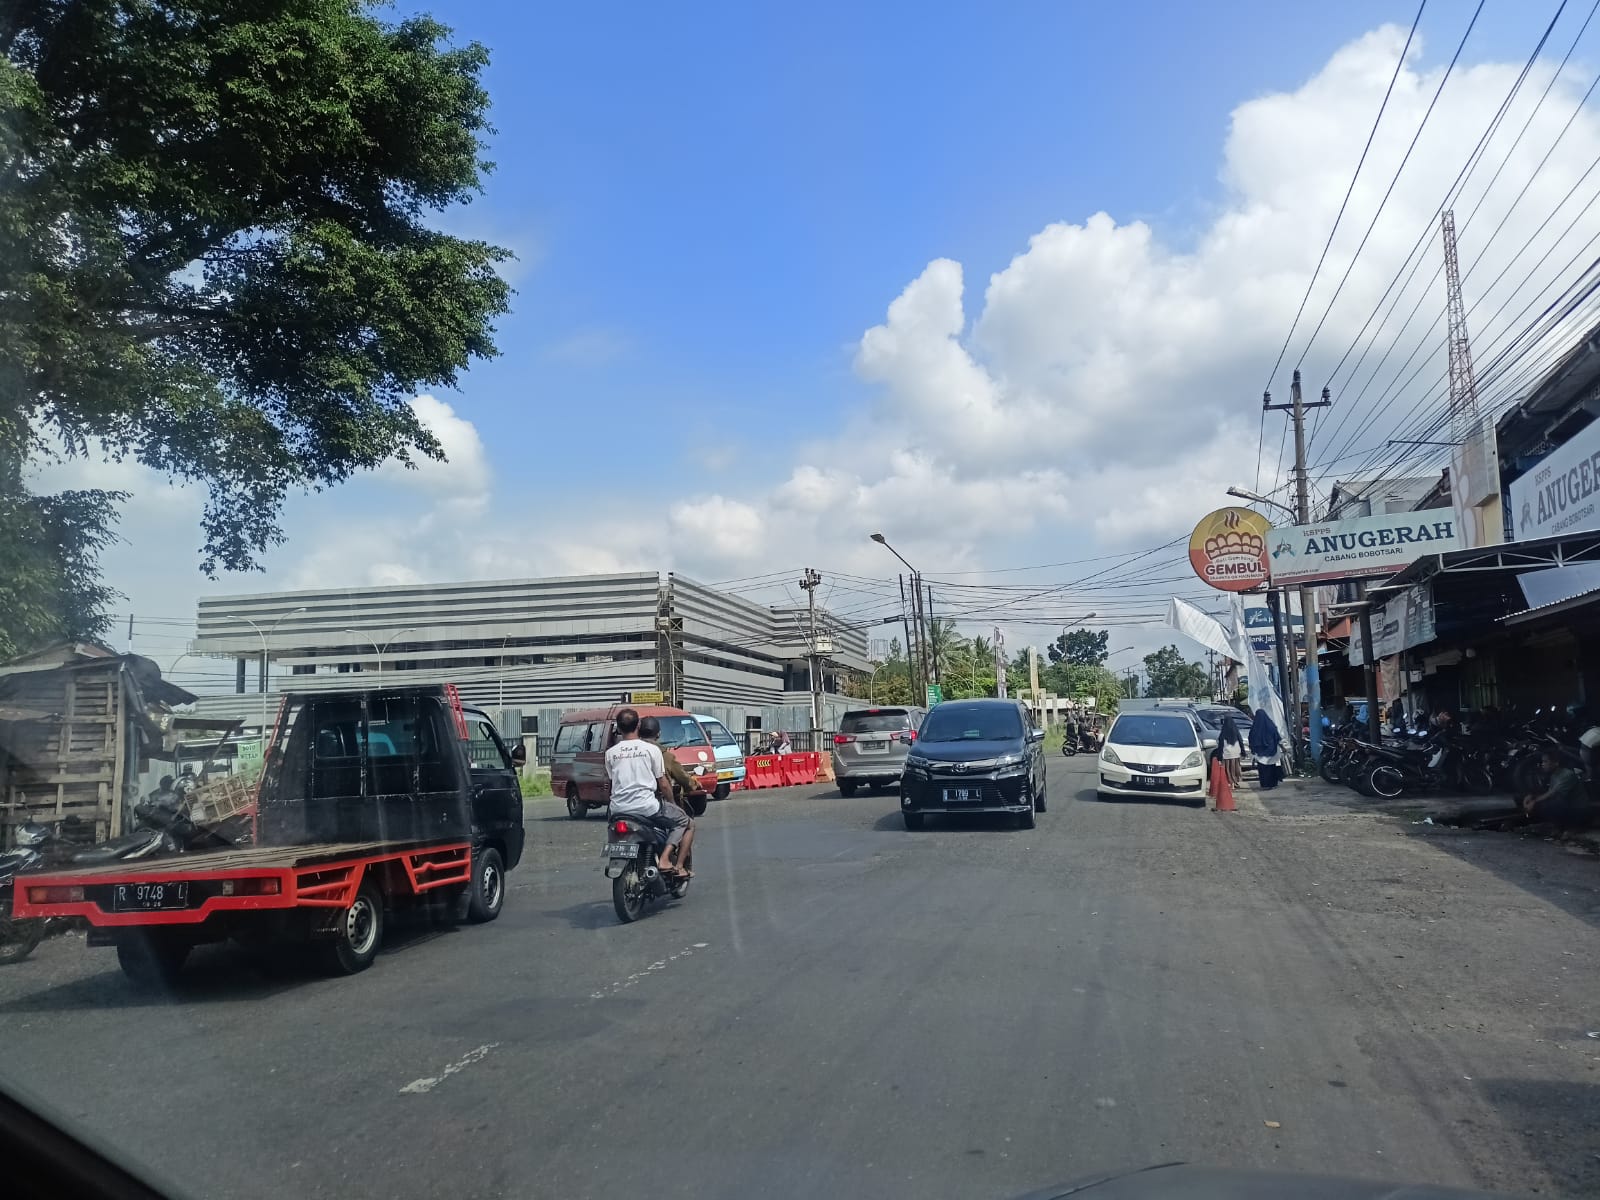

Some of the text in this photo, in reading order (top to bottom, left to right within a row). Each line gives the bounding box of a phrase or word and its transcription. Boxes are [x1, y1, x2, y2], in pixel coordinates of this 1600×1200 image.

[1303, 527, 1331, 537] KSPPS
[1304, 521, 1455, 555] ANUGERAH
[1324, 547, 1404, 562] CABANG BOBOTSARI
[1205, 562, 1266, 576] GEMBUL
[118, 884, 184, 901] R 9748 L
